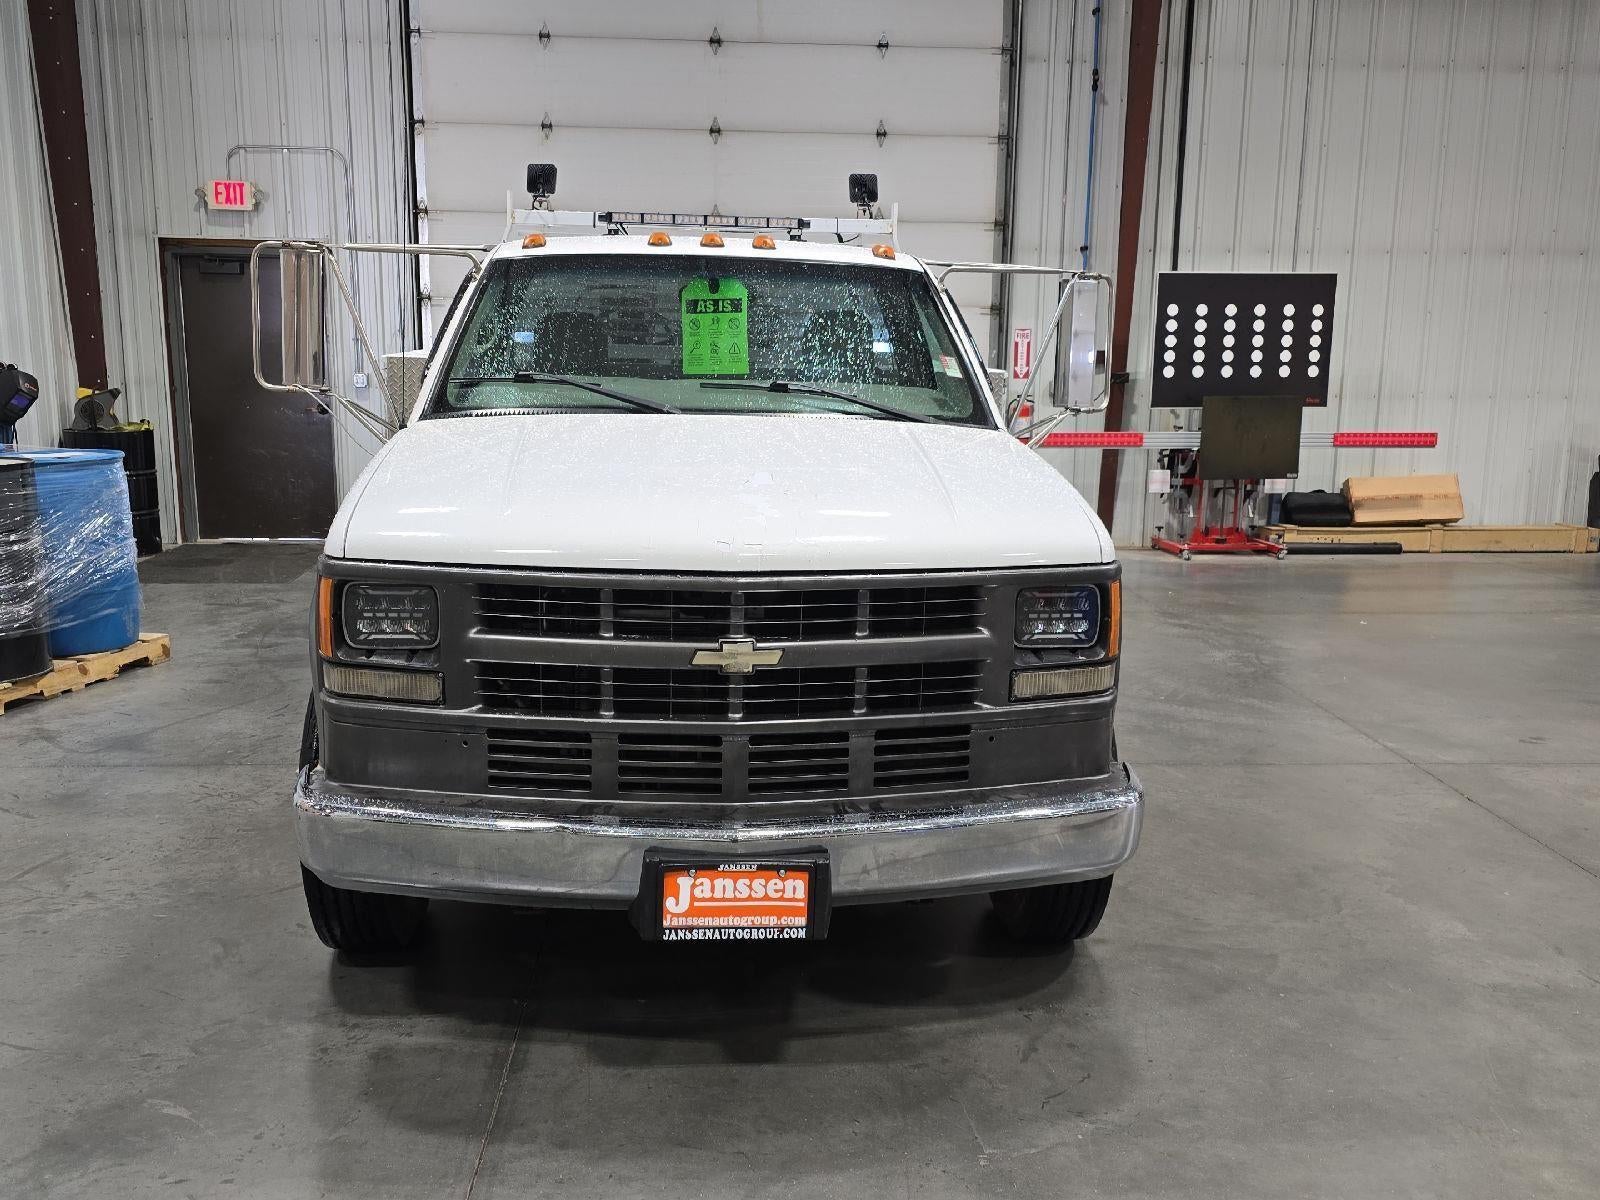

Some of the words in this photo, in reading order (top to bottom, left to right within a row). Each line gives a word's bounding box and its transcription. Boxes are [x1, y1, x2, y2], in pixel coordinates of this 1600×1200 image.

[214, 181, 245, 206] EXIT
[697, 300, 715, 312] AS
[719, 300, 732, 312] IS
[1016, 332, 1030, 340] FIRE
[665, 876, 805, 913] Janssen
[663, 914, 806, 927] Janssenautogroup.com
